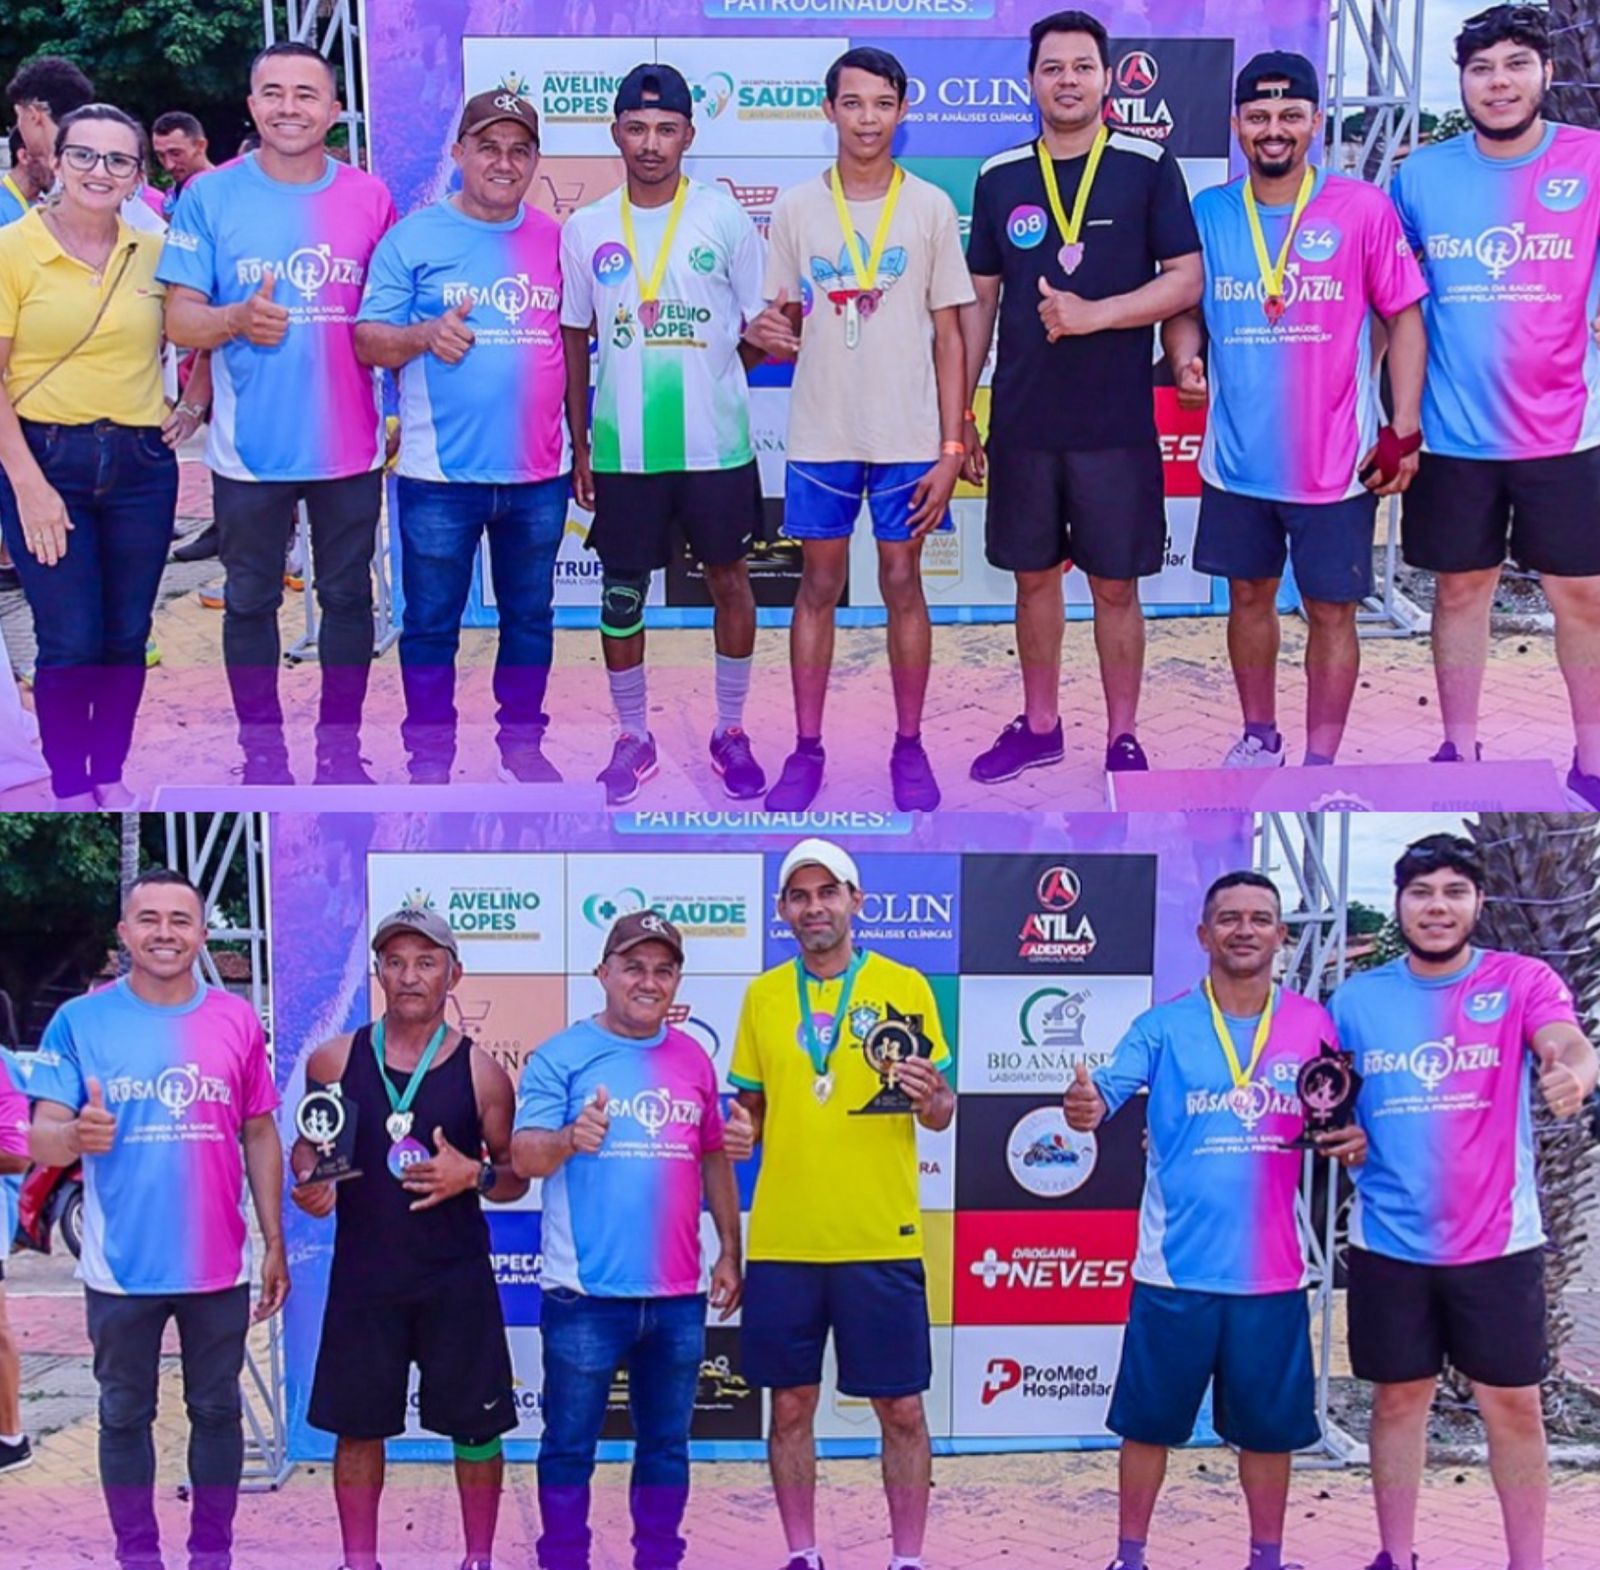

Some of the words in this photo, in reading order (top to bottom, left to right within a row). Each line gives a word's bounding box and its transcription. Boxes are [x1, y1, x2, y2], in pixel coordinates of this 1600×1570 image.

[543, 96, 608, 114] LOPES
[1545, 179, 1580, 198] 57
[1013, 214, 1042, 237] 08
[1301, 230, 1334, 248] 34
[1427, 238, 1473, 260] ROSA
[1522, 238, 1574, 261] AZUL
[599, 253, 625, 273] 49
[1214, 282, 1257, 301] ROSA
[1298, 280, 1345, 301] AZUL
[635, 812, 892, 828] PATROCINADORES:
[449, 891, 541, 911] AVELINO
[450, 912, 516, 931] LOPES
[650, 901, 747, 924] SAÚDE
[1471, 991, 1503, 1011] 57
[987, 1052, 1022, 1069] BIO
[1363, 1051, 1407, 1075] ROSA
[1454, 1048, 1501, 1073] AZUL
[107, 1082, 155, 1104] ROSA
[1186, 1093, 1228, 1115] ROSA
[1012, 1247, 1077, 1259] DROGARIA
[1006, 1260, 1128, 1288] NEVES
[1023, 1364, 1098, 1381] ProMed
[1023, 1382, 1113, 1400] Hospitalar
